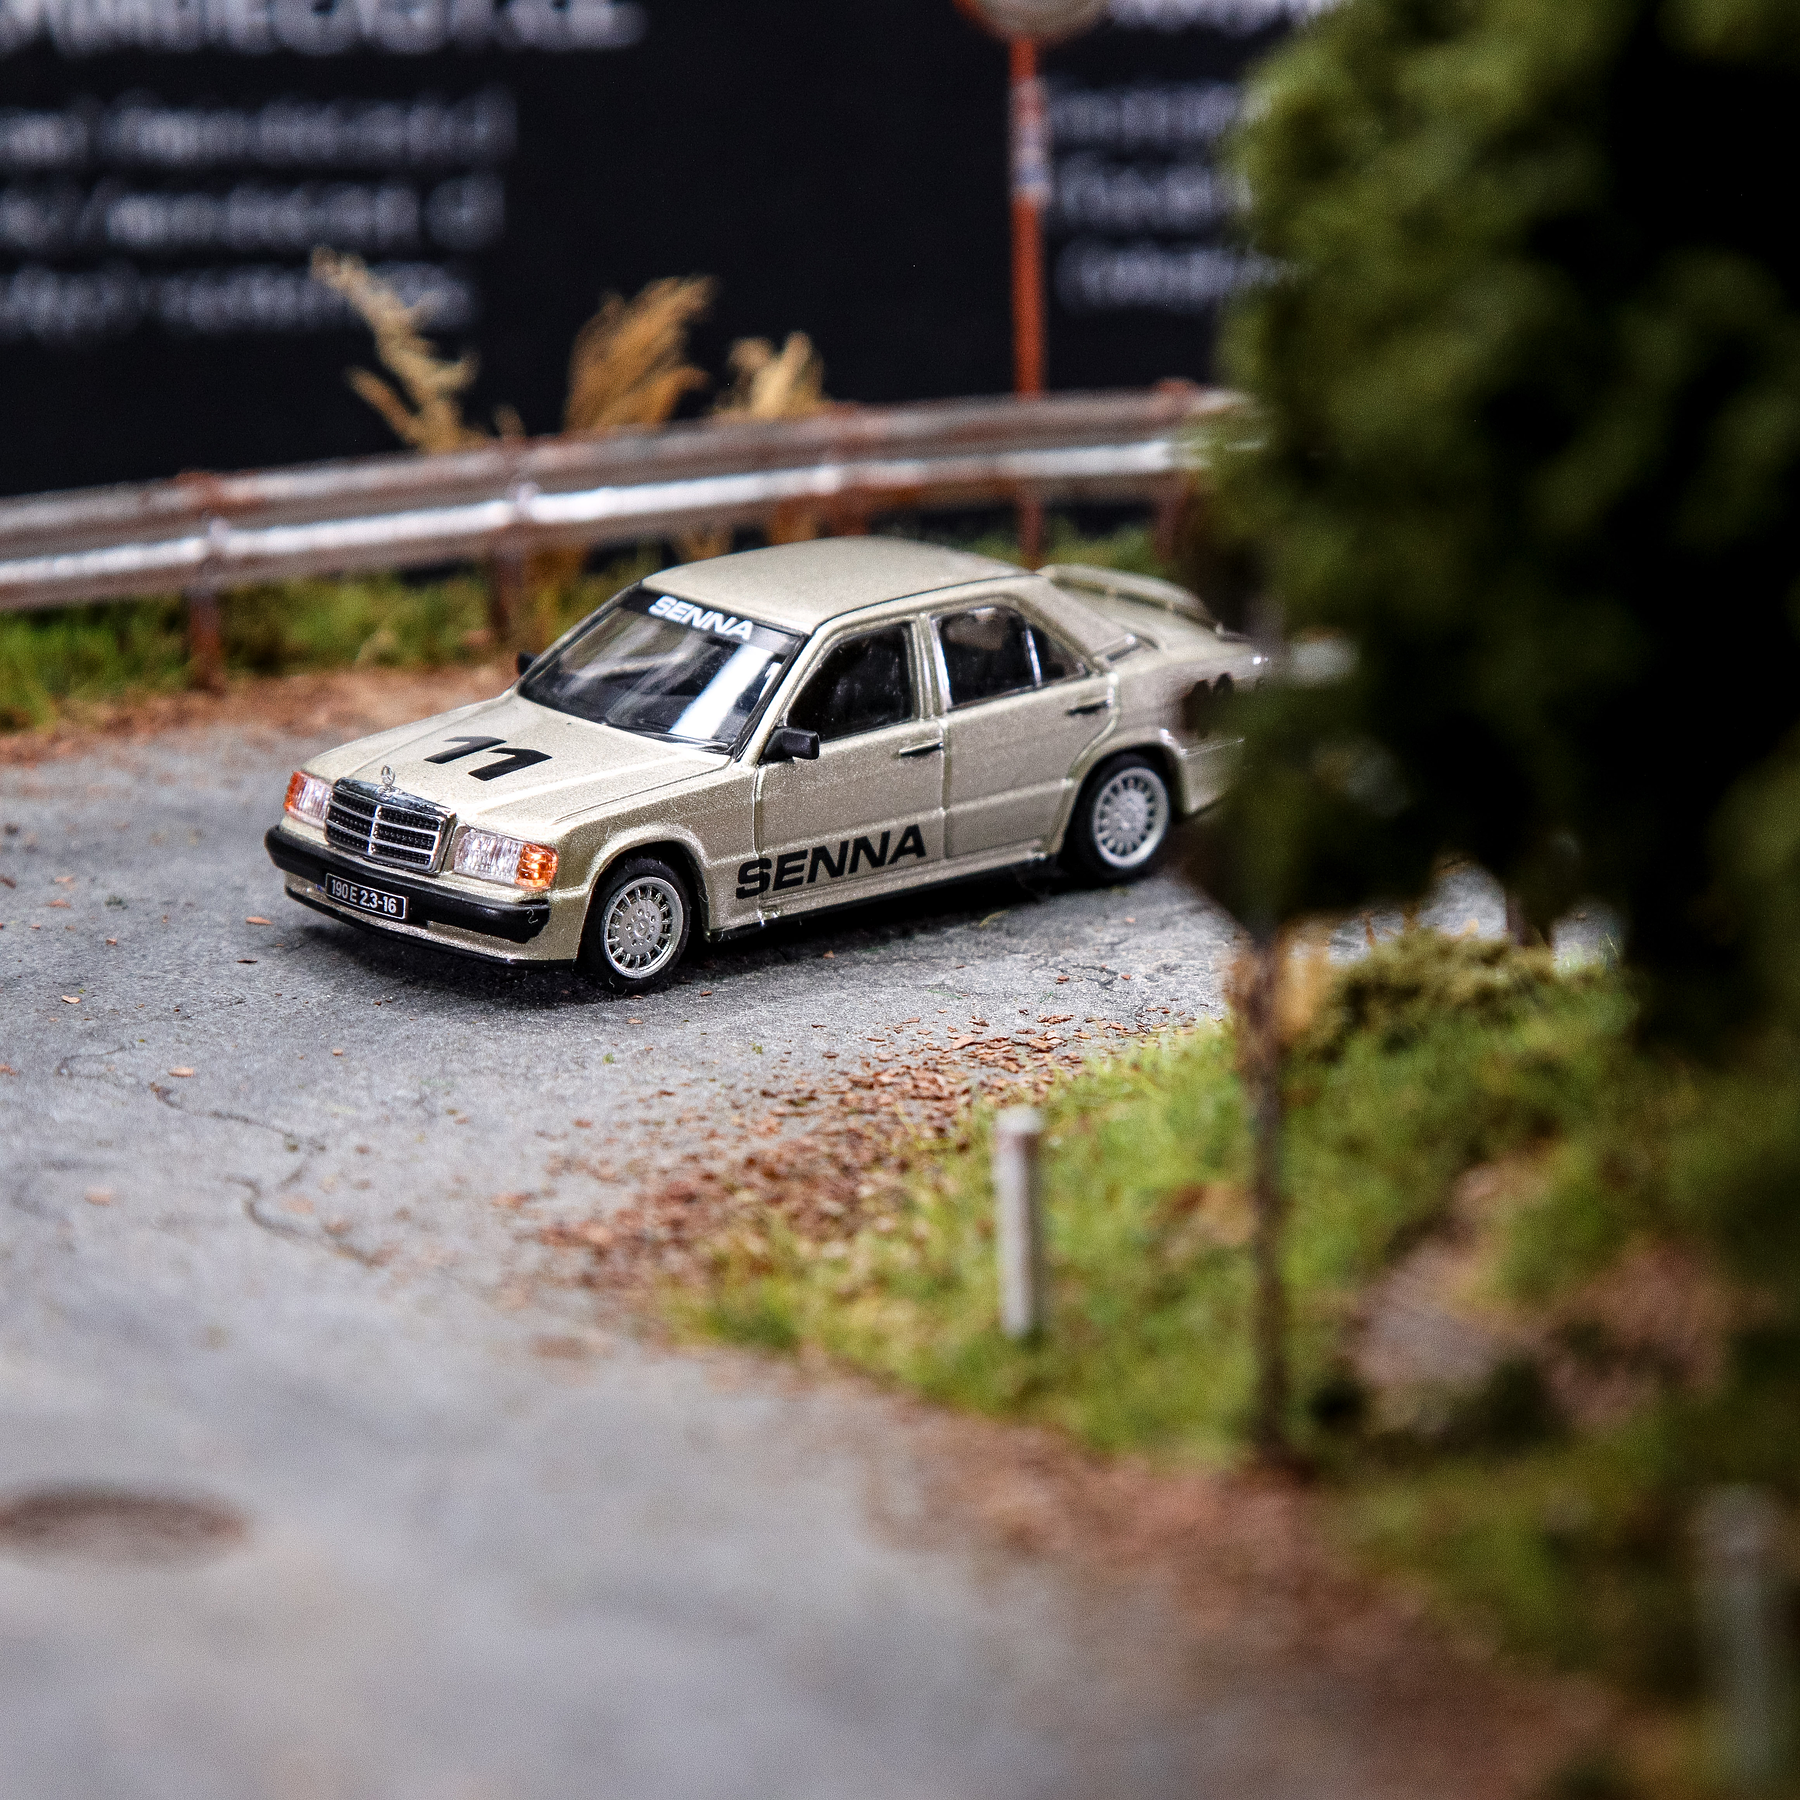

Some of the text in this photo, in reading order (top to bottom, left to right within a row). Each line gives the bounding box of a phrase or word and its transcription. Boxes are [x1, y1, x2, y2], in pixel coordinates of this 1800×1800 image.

[648, 595, 754, 640] SENNA
[423, 735, 553, 782] 11
[735, 823, 927, 900] SENNA
[359, 889, 397, 914] 2.3-16
